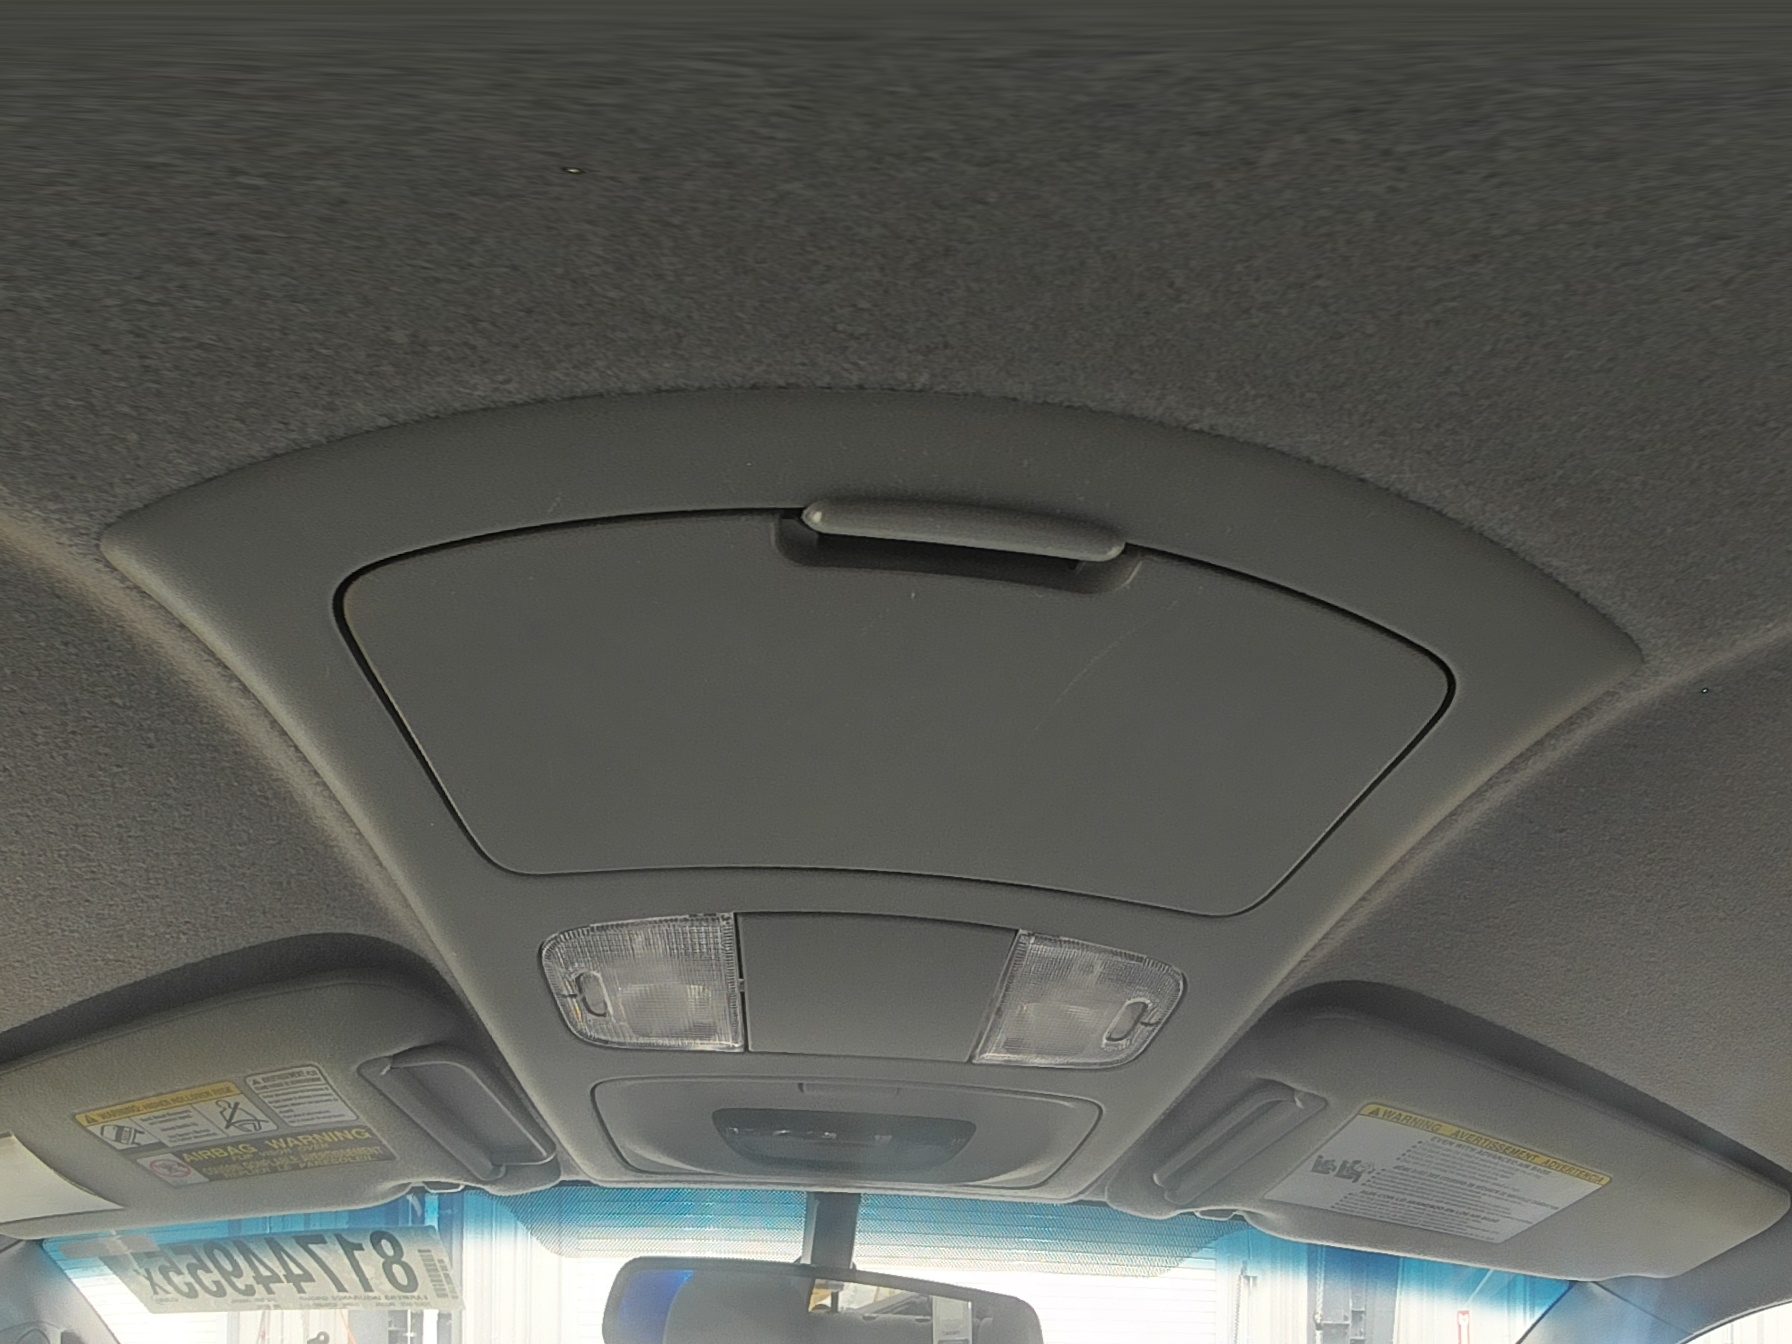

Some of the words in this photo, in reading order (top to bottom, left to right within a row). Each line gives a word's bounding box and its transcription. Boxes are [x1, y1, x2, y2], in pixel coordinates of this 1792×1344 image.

[182, 1143, 258, 1163] AIRBAG
[264, 1128, 373, 1150] WARNING
[1380, 1109, 1442, 1133] WARNING
[1450, 1129, 1540, 1162] AVERTISSEMENT
